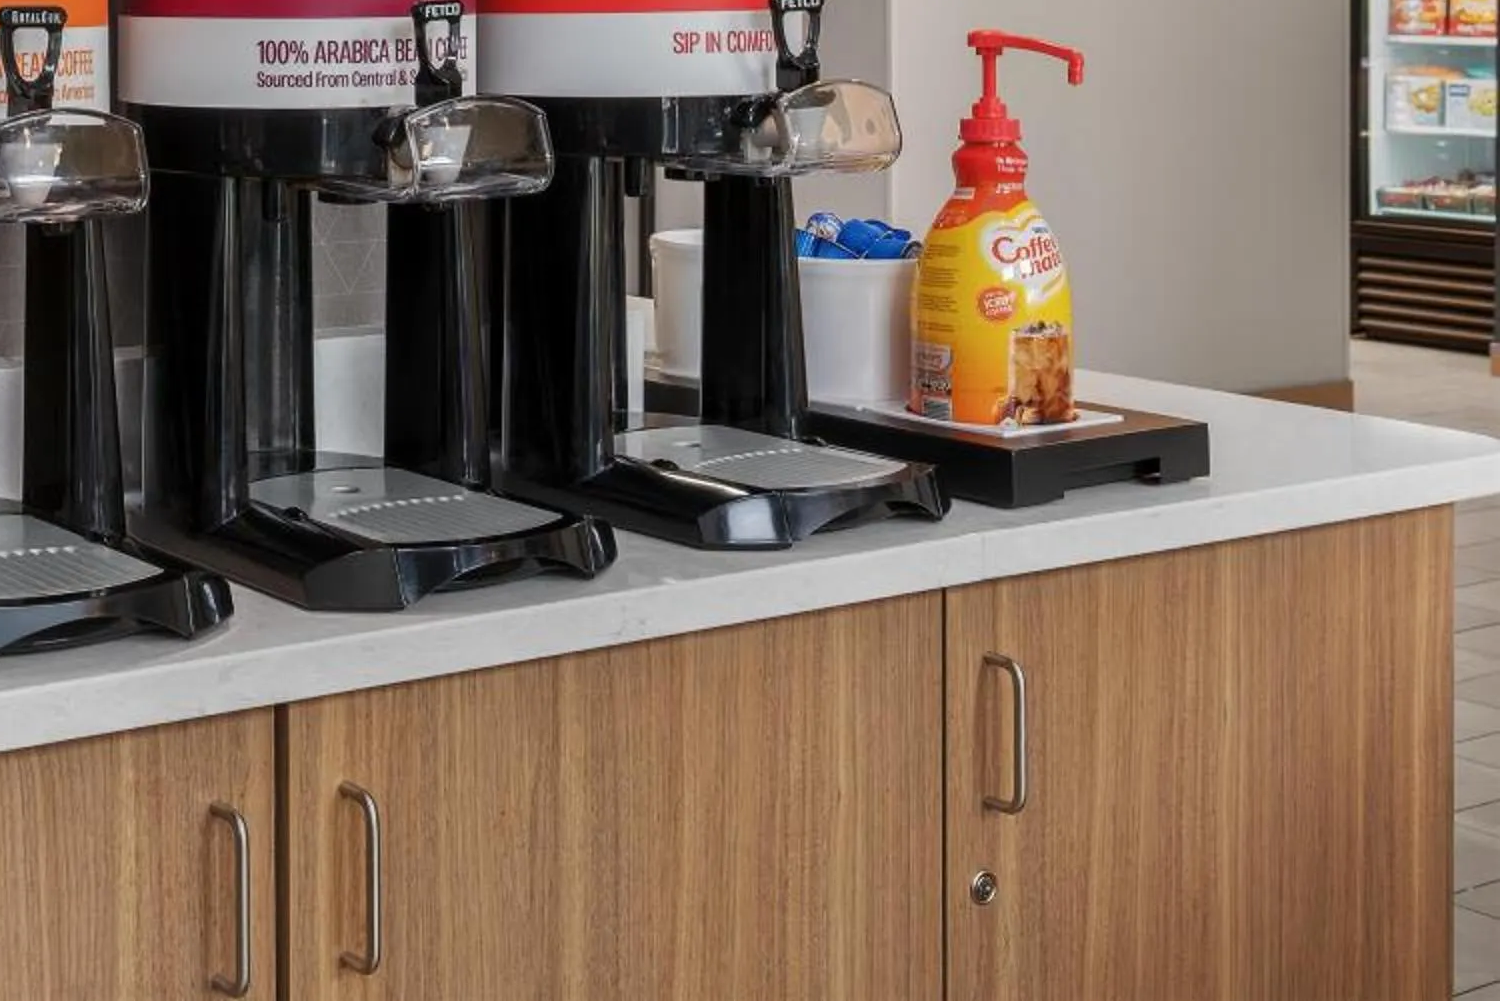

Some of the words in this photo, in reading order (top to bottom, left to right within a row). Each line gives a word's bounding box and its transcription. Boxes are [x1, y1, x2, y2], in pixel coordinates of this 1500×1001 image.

[257, 40, 309, 64] 100%
[314, 39, 389, 64] ARABICA
[673, 31, 700, 54] SIP
[706, 31, 721, 53] IN
[727, 30, 773, 53] COMFO
[257, 70, 313, 88] Sourced
[315, 71, 349, 87] From
[352, 70, 397, 87] Central
[398, 71, 408, 86] &
